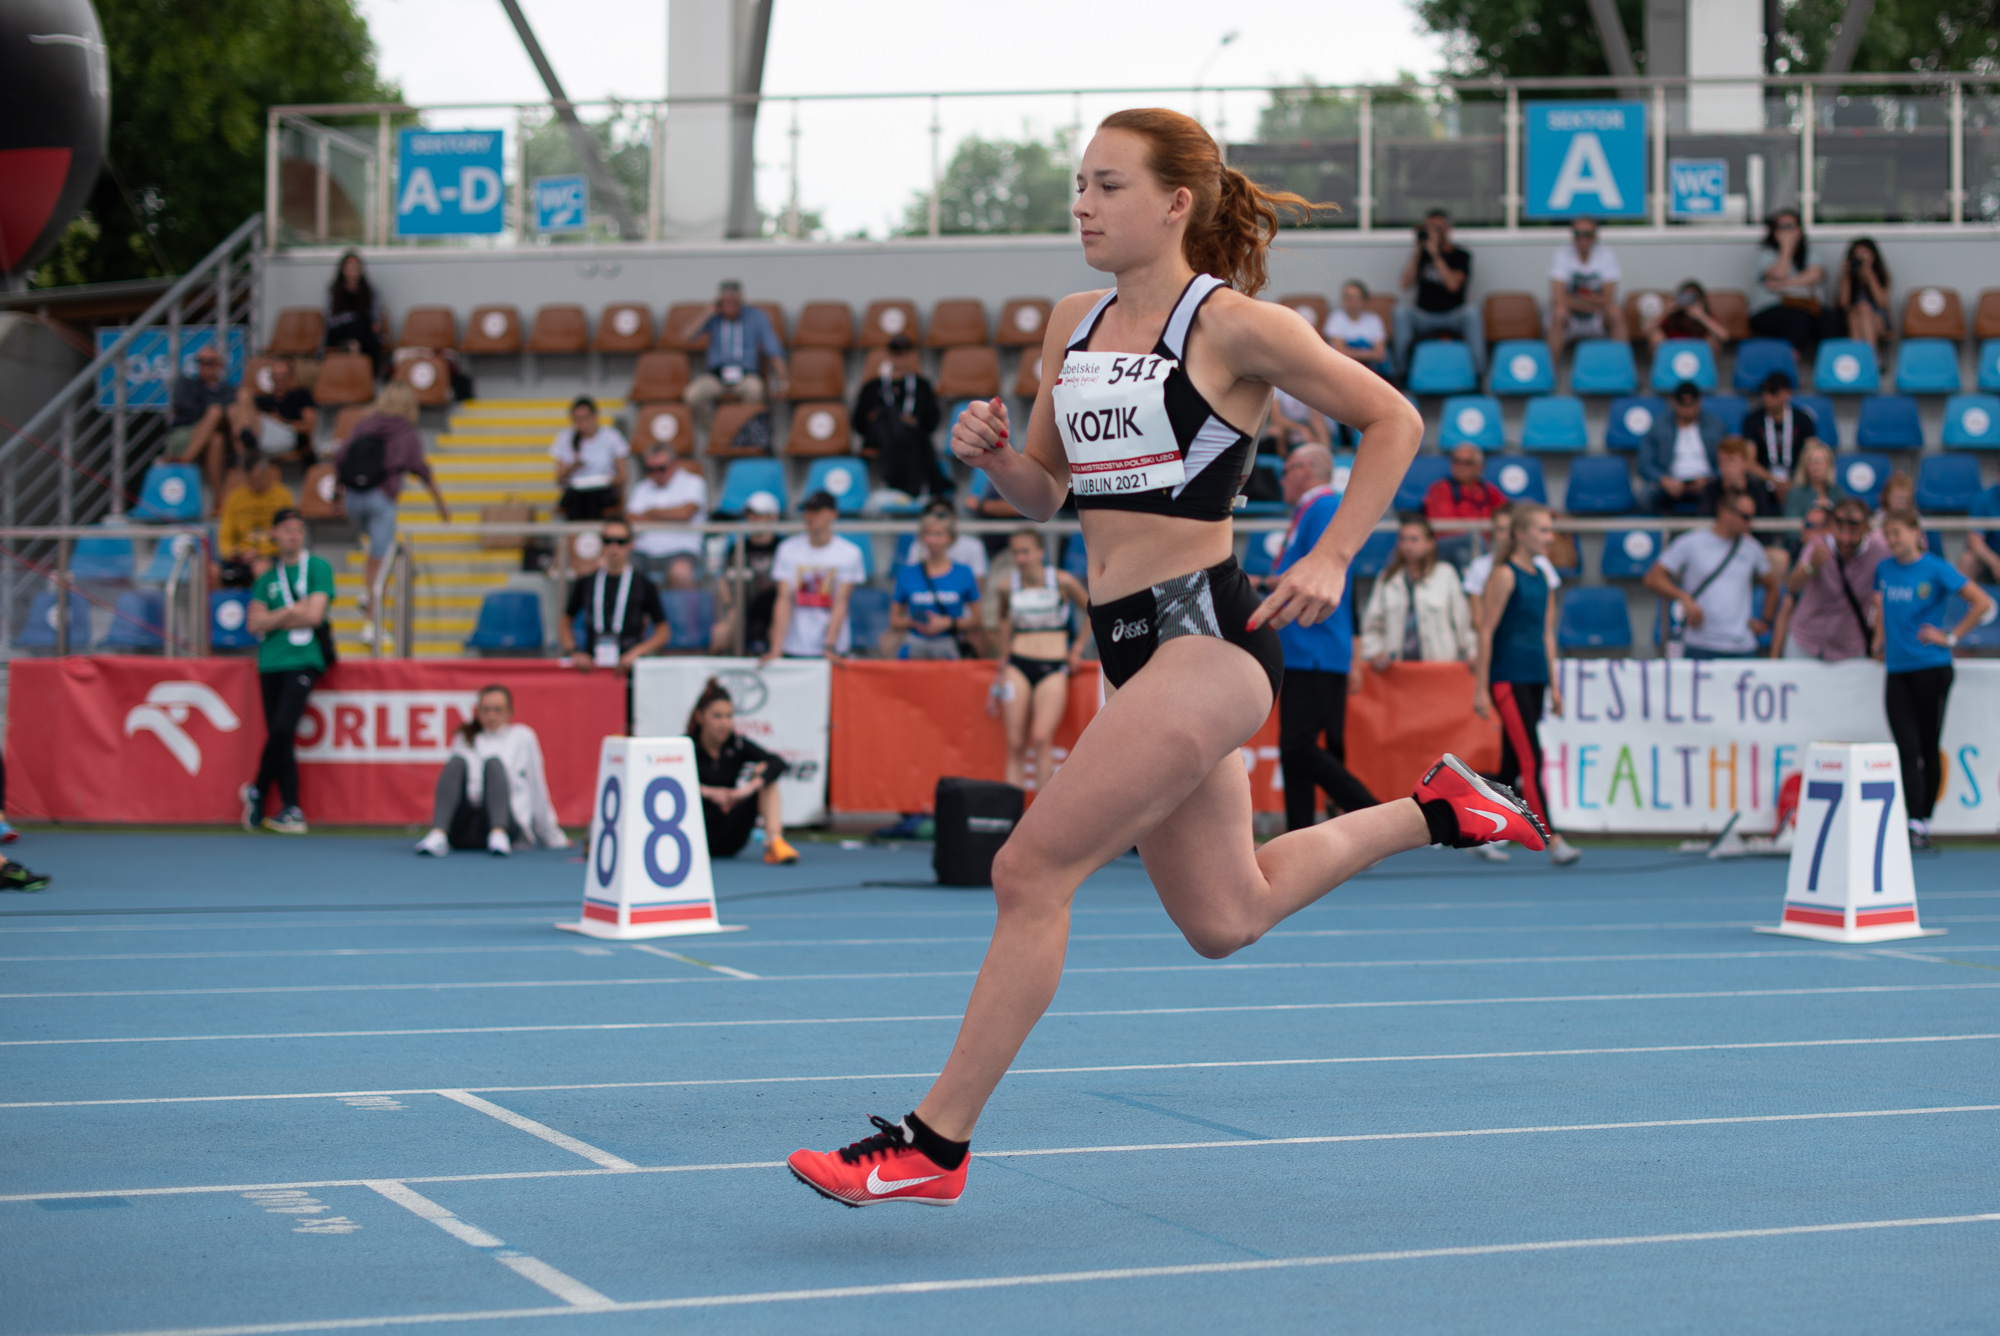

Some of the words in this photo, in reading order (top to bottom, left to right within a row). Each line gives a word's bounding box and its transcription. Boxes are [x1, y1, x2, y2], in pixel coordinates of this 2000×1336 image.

[1547, 109, 1625, 131] SEKTOR
[411, 134, 494, 156] SEKTORY
[400, 166, 500, 215] A-D
[1547, 132, 1625, 209] A
[1674, 168, 1722, 196] WC
[1061, 363, 1101, 376] ubelskie
[1107, 356, 1164, 385] 541
[1066, 405, 1144, 443] KOZIK
[1080, 461, 1124, 473] MISTRZOSTWA
[1124, 456, 1155, 468] POLSKI
[1080, 477, 1112, 493] LUBLIN
[1116, 472, 1148, 490] 2021
[1736, 670, 1798, 723] for
[597, 775, 621, 888] 8
[643, 776, 692, 888] 8
[1807, 781, 1843, 892] 7
[1860, 781, 1895, 893] 7
